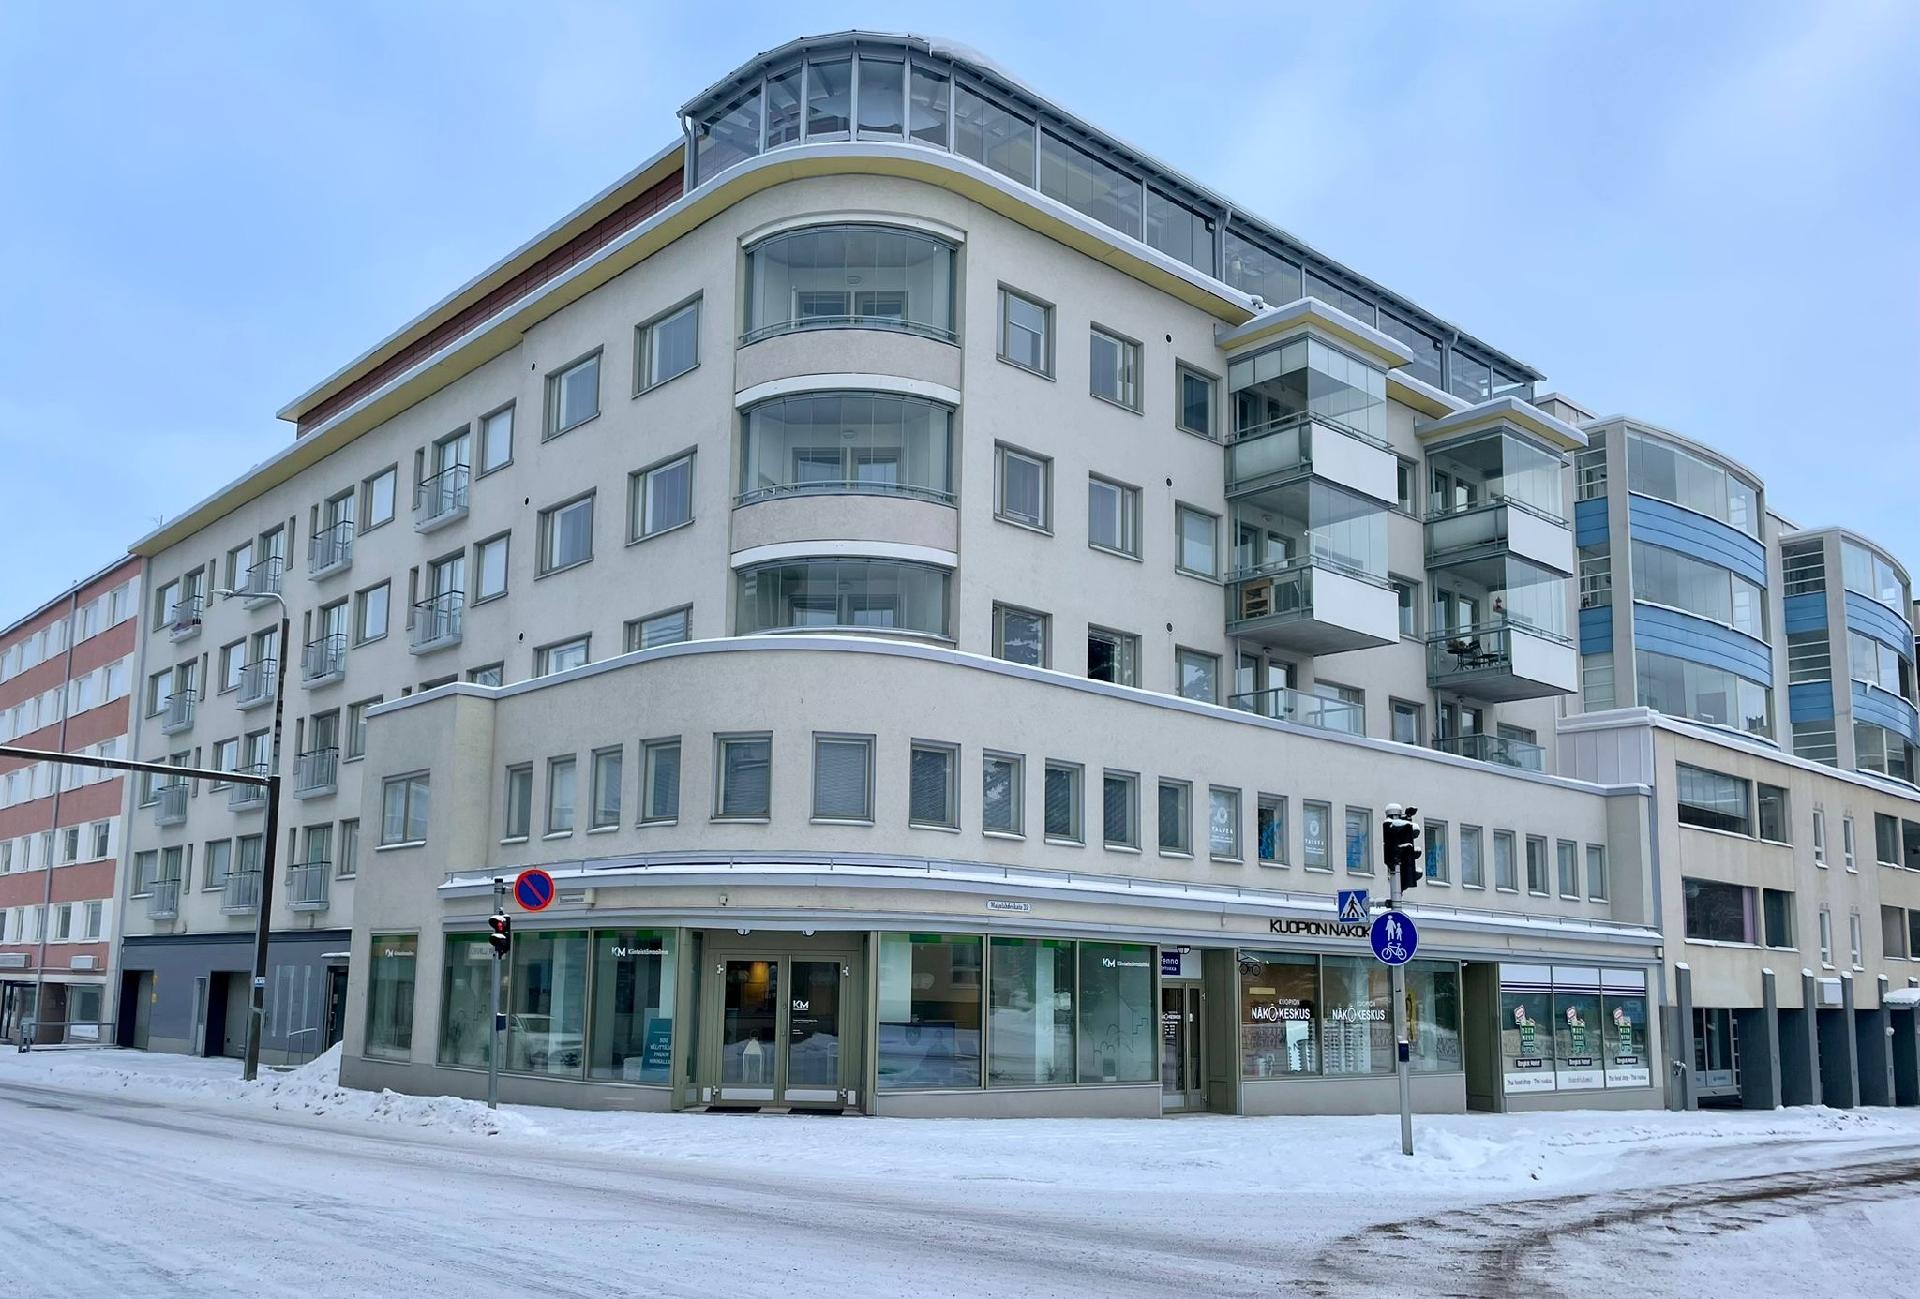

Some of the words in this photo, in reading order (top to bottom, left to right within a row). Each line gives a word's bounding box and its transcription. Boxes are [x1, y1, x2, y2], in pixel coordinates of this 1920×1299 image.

[1270, 919, 1327, 936] KUOPION
[611, 946, 626, 957] KM
[1102, 957, 1116, 967] KM
[793, 1000, 809, 1009] KM
